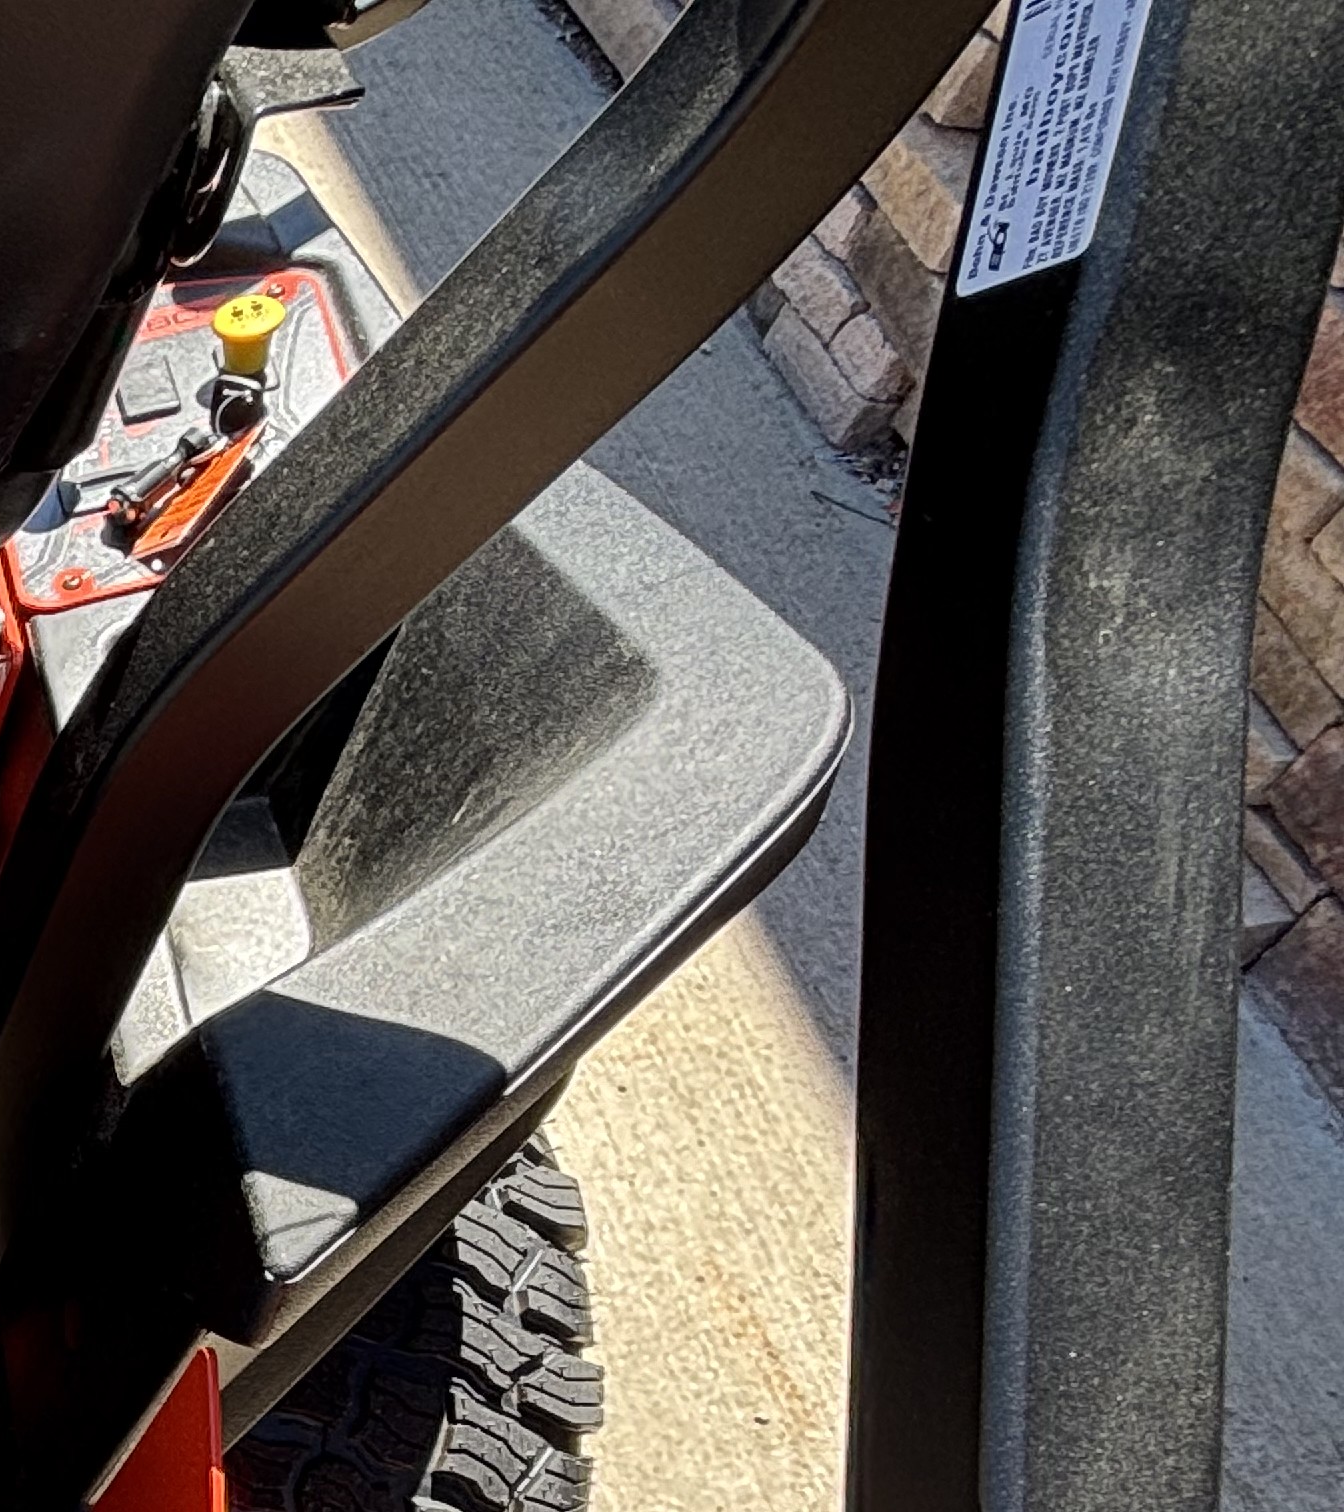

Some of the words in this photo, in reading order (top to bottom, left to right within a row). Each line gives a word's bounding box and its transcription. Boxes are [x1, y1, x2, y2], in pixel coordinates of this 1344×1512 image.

[1001, 95, 1019, 131] Inc.
[983, 136, 1009, 209] Dawson
[980, 214, 991, 226] &
